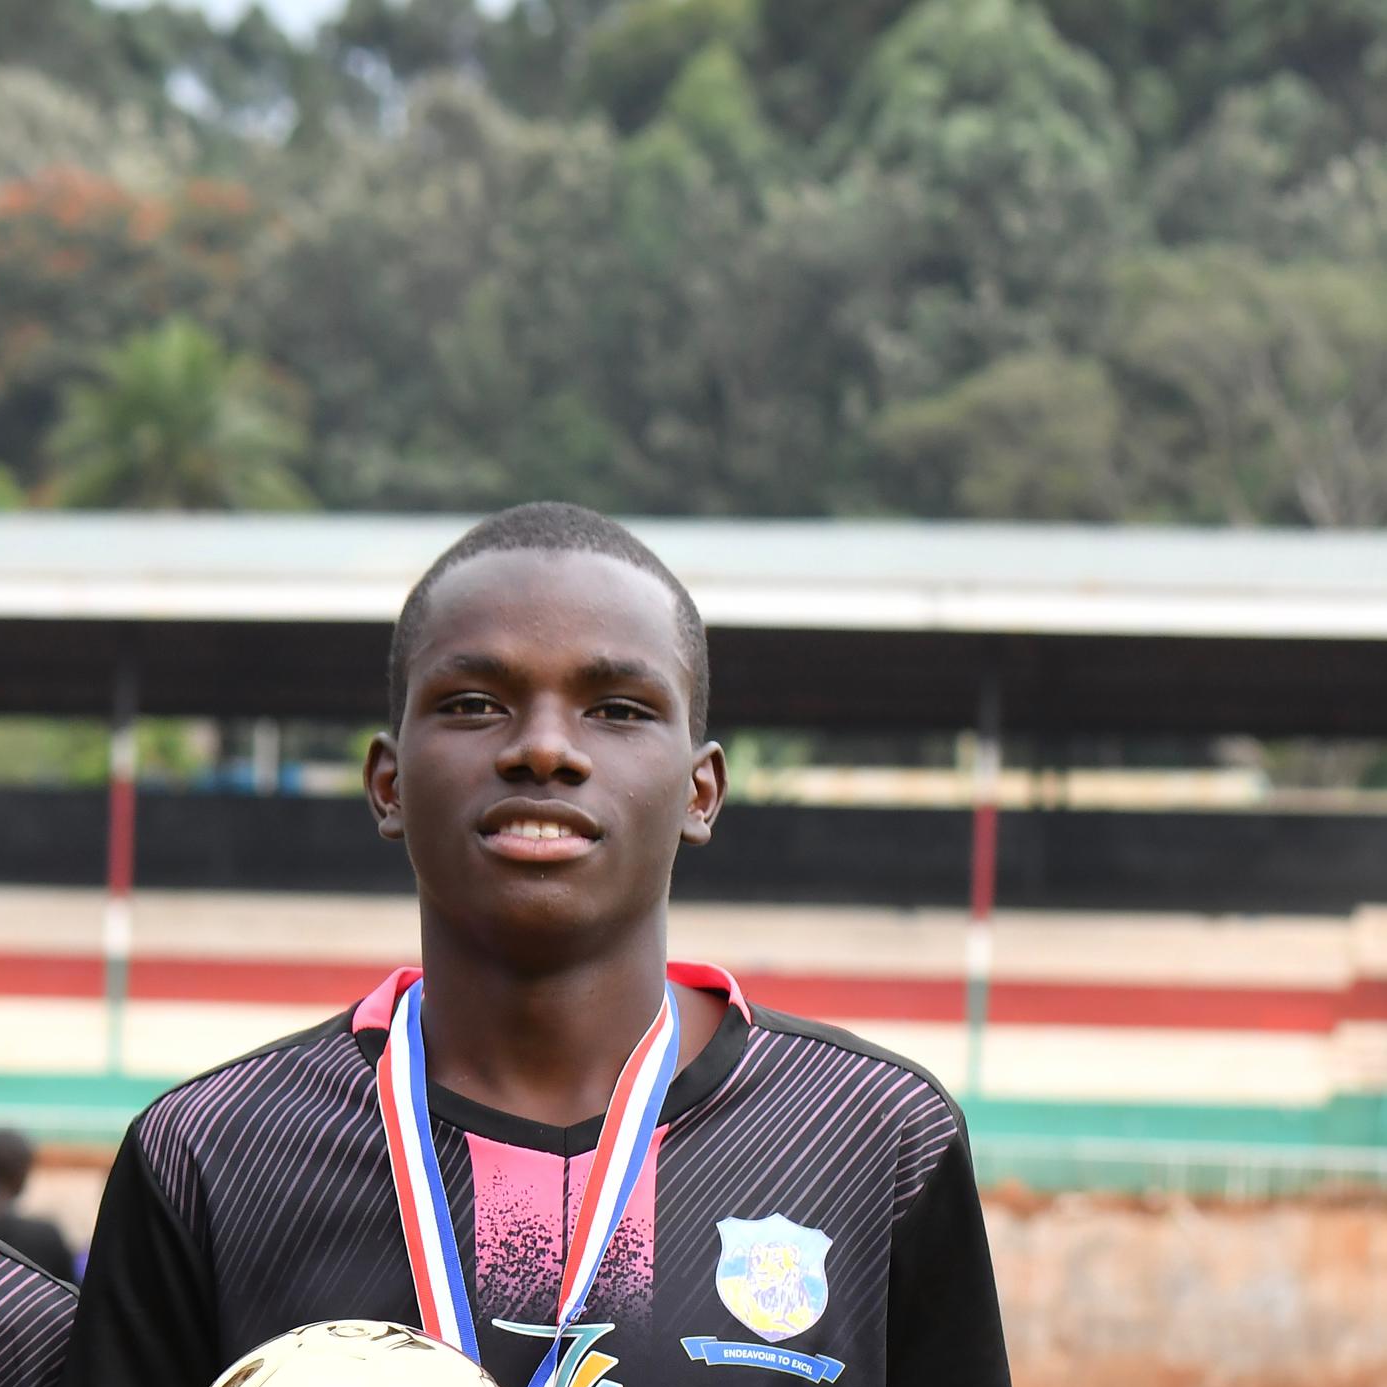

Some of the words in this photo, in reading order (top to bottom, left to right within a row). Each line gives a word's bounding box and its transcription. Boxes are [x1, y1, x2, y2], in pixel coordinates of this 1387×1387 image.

[723, 1349, 776, 1362] ENDEAVOUR
[778, 1355, 790, 1365] TO
[791, 1359, 813, 1375] EXCEL
